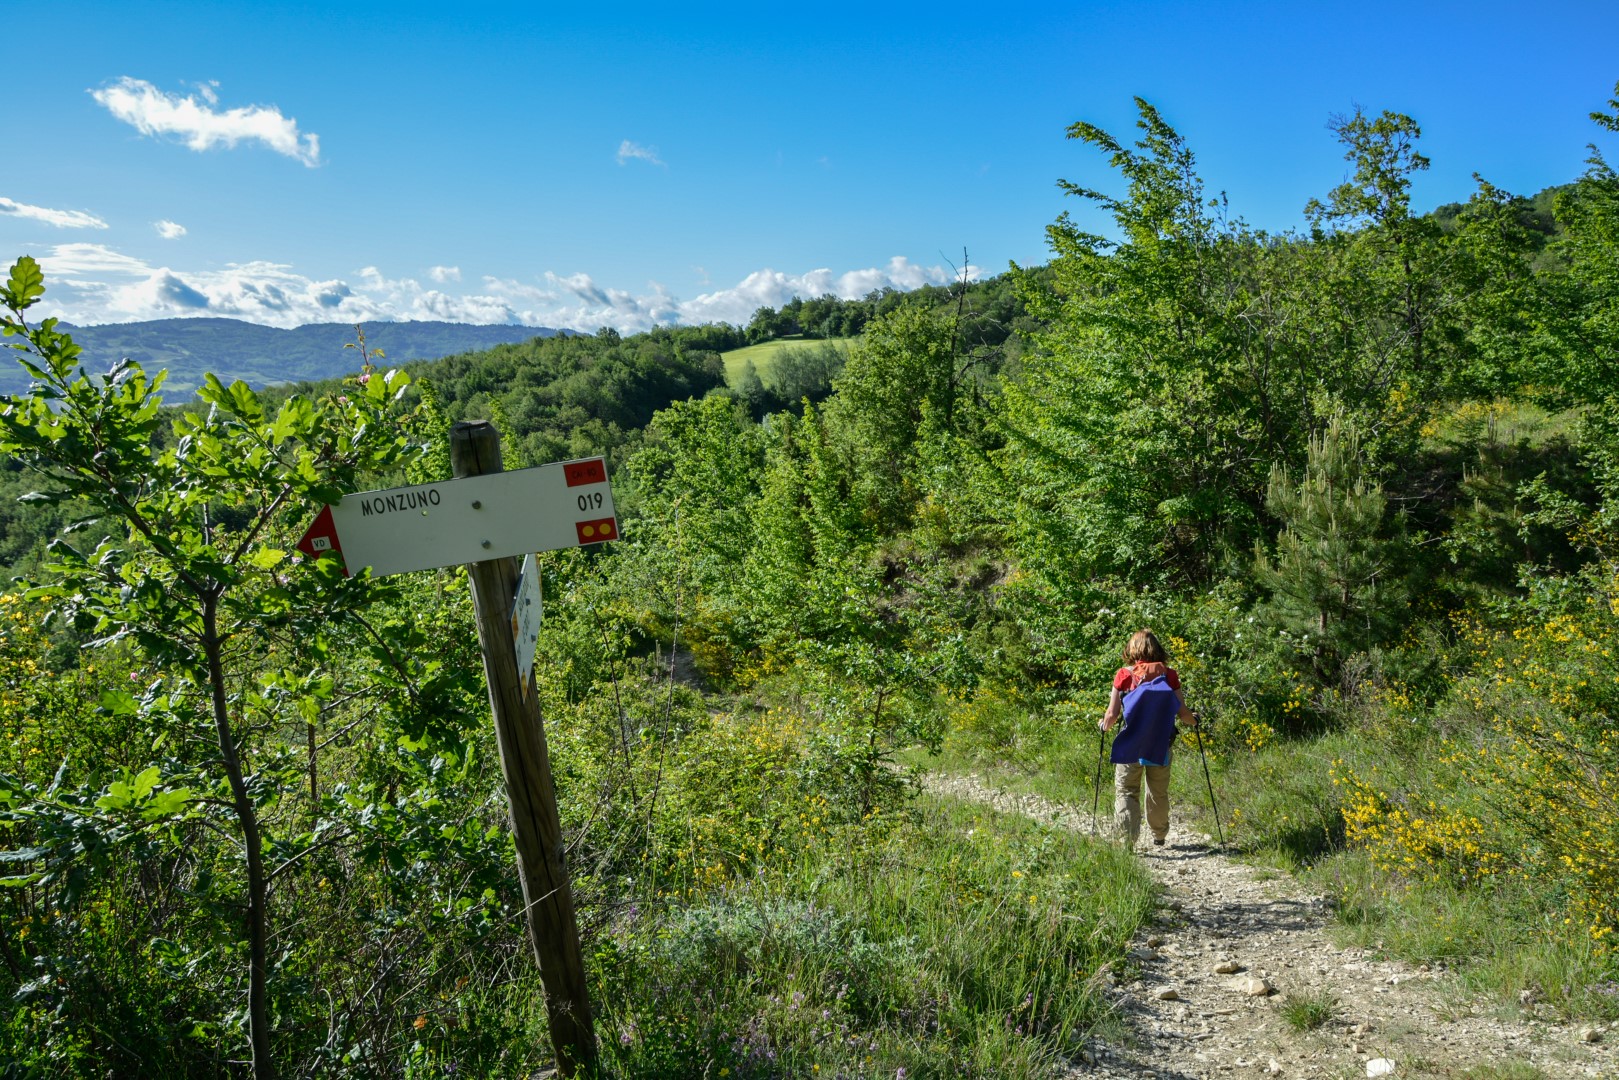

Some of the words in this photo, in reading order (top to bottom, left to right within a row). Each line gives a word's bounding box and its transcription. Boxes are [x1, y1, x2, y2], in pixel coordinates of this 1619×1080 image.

[361, 489, 441, 517] MONZUNO
[577, 492, 604, 512] 019
[313, 538, 326, 548] VD
